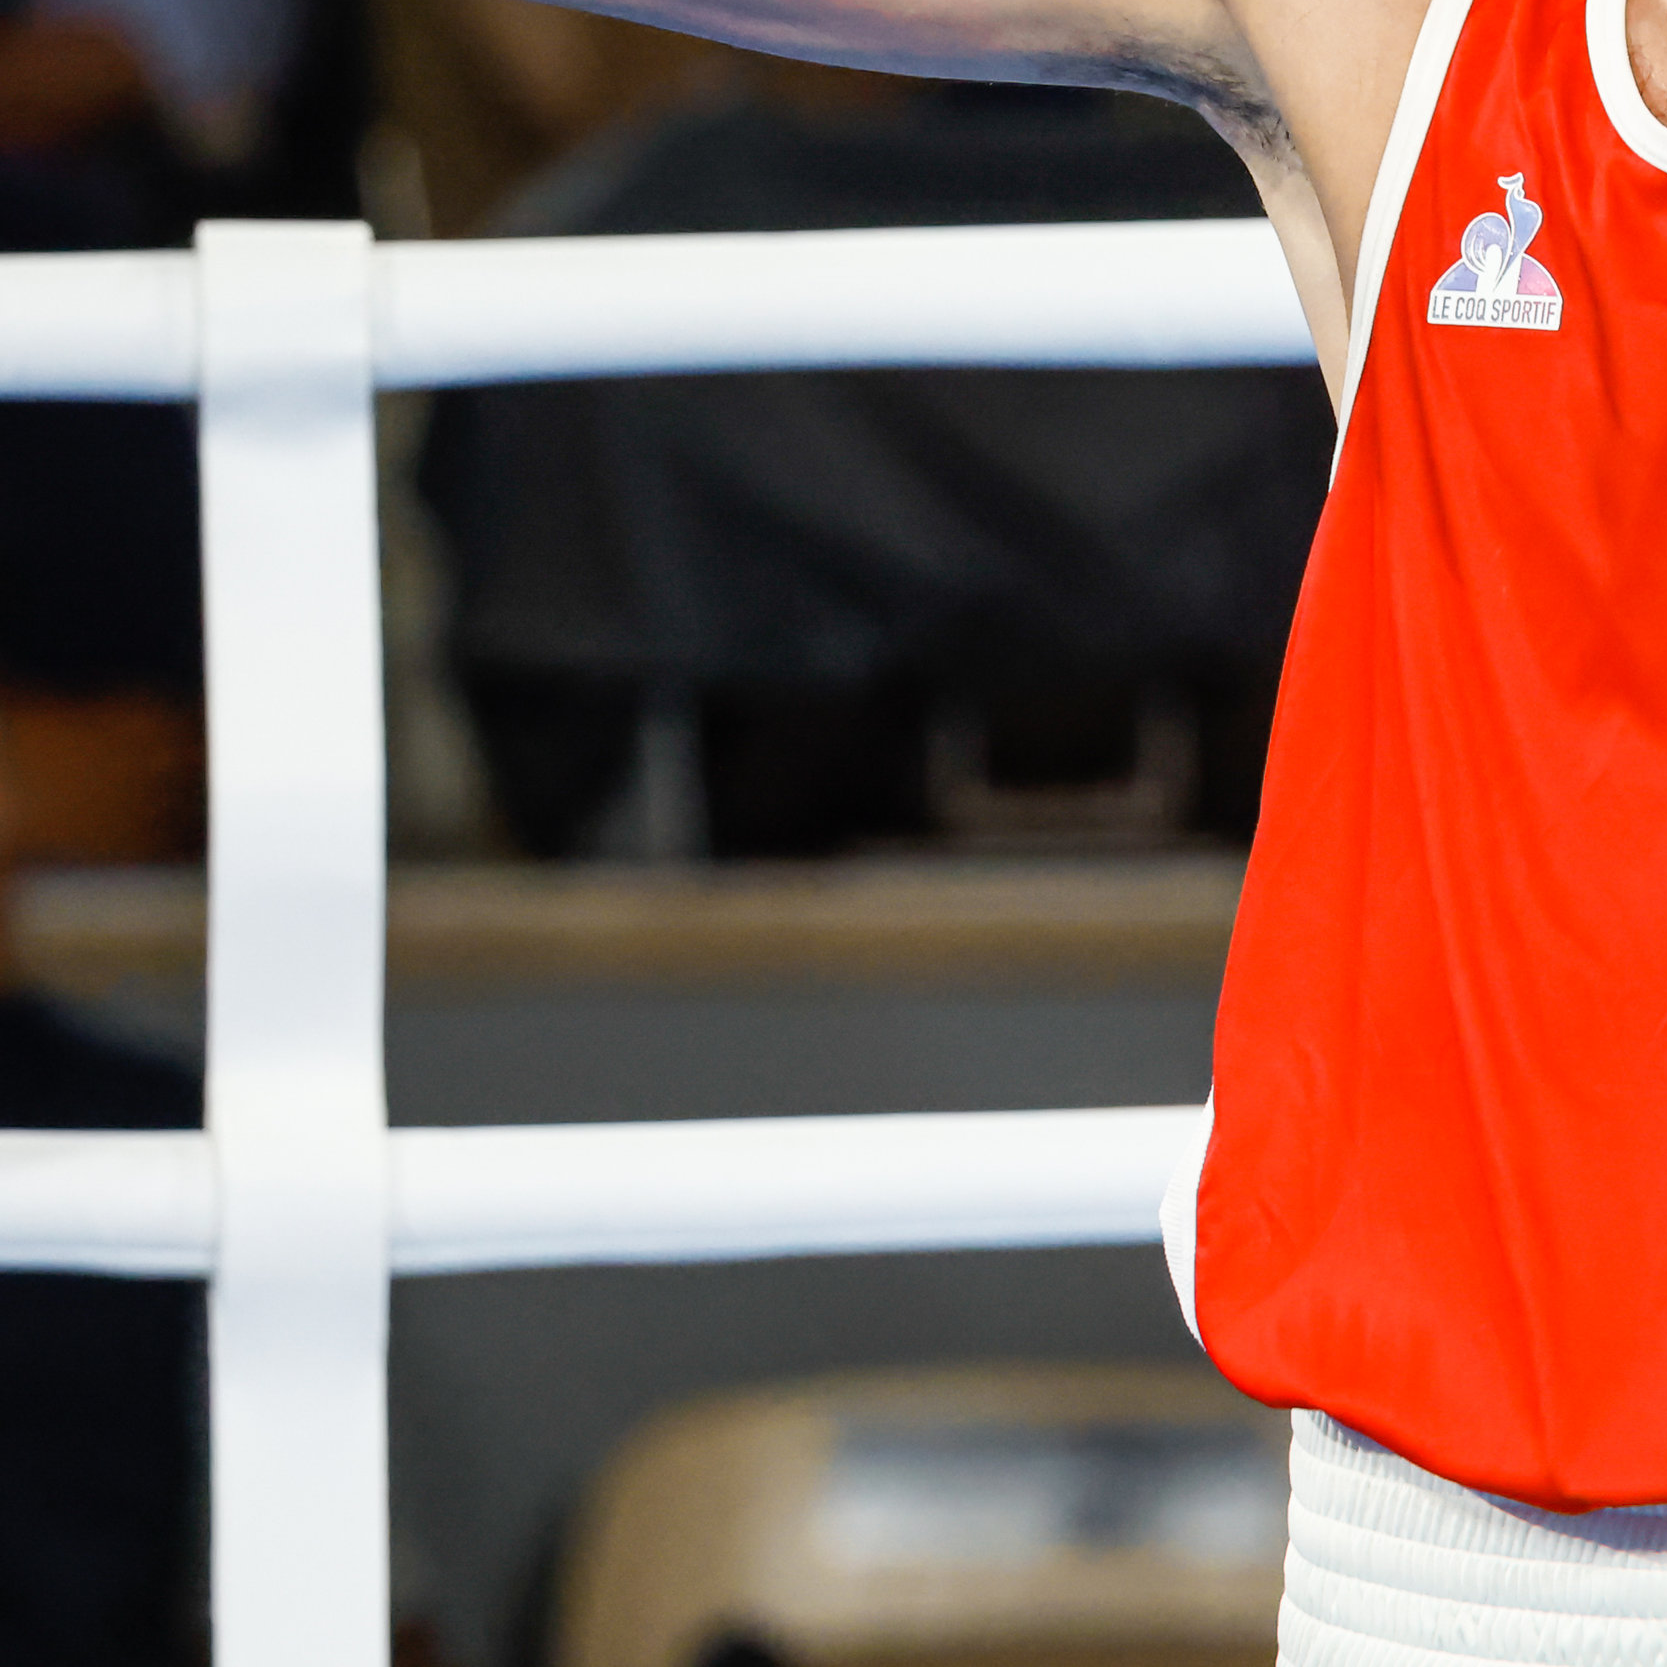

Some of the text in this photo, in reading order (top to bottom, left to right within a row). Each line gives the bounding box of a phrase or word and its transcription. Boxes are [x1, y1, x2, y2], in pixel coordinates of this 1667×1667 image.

[1433, 297, 1556, 324] LE COQ SPORTIF
